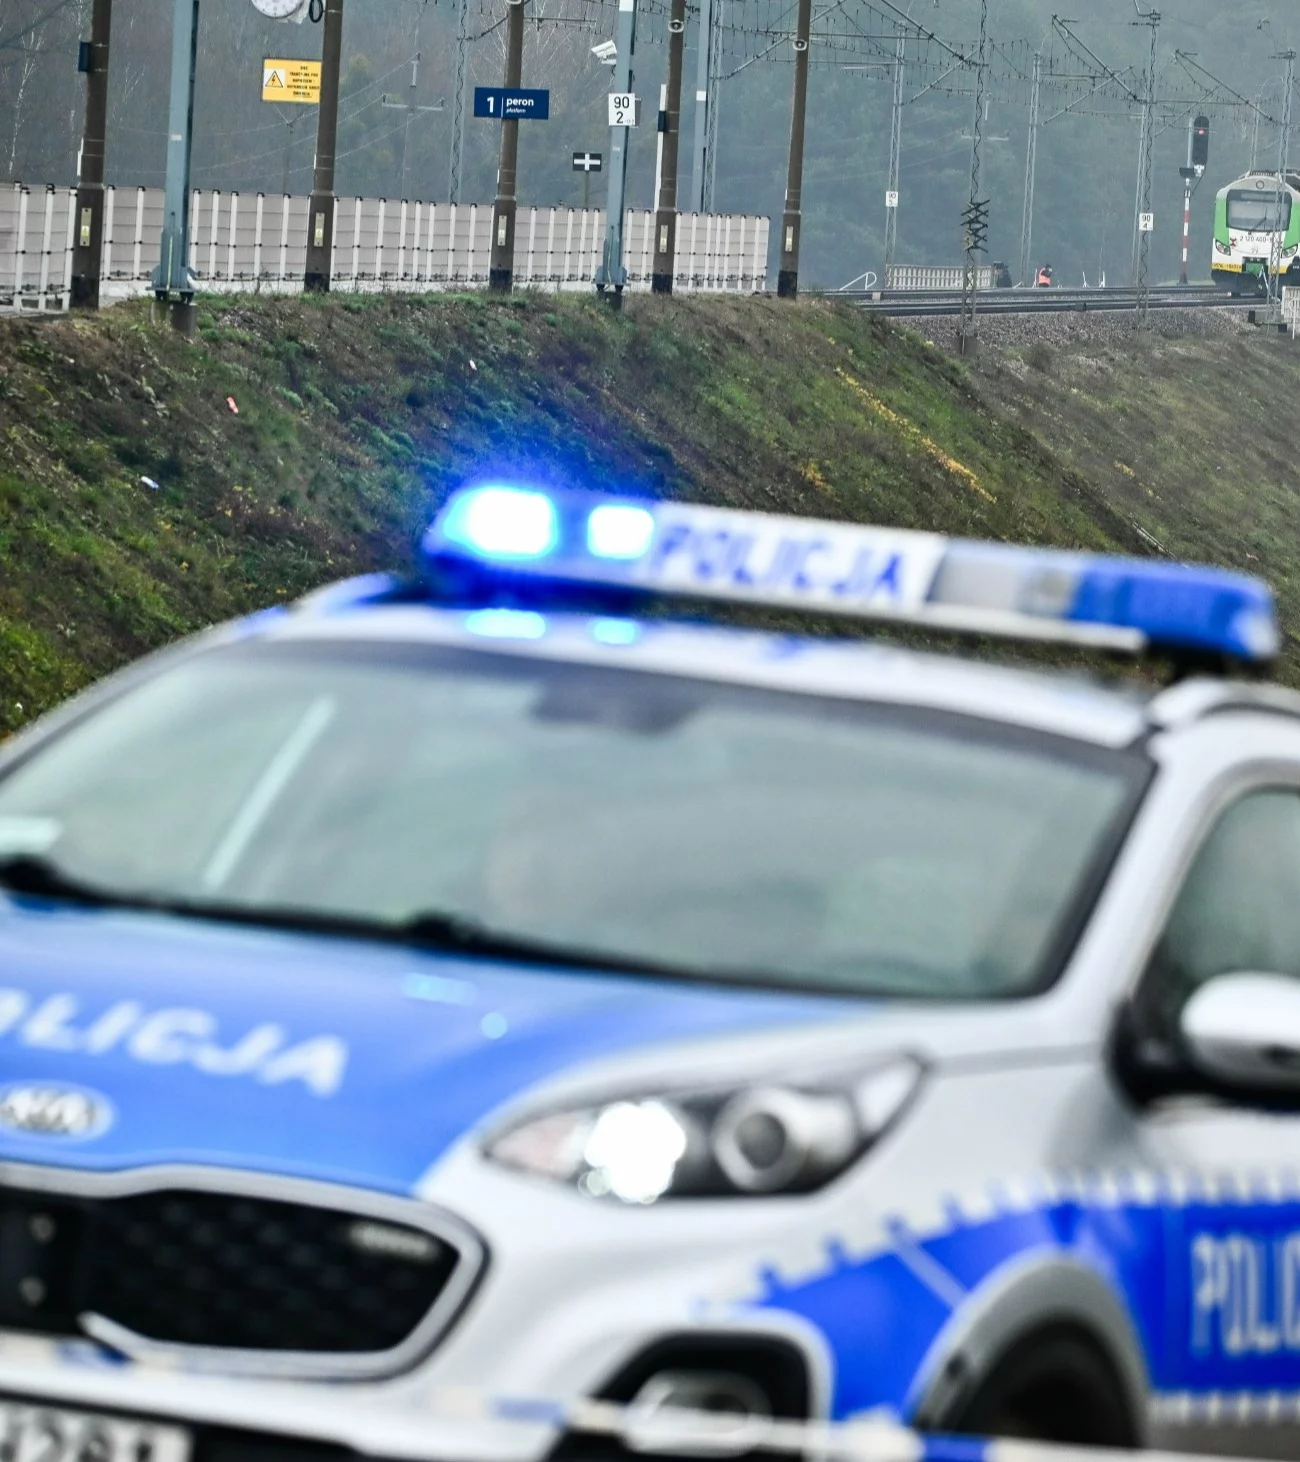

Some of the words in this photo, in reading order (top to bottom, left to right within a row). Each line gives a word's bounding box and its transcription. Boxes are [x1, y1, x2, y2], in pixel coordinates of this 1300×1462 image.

[487, 96, 494, 113] 1
[506, 98, 534, 107] peron
[614, 96, 629, 109] 90
[616, 111, 623, 124] 2
[656, 524, 903, 600] POLICJA
